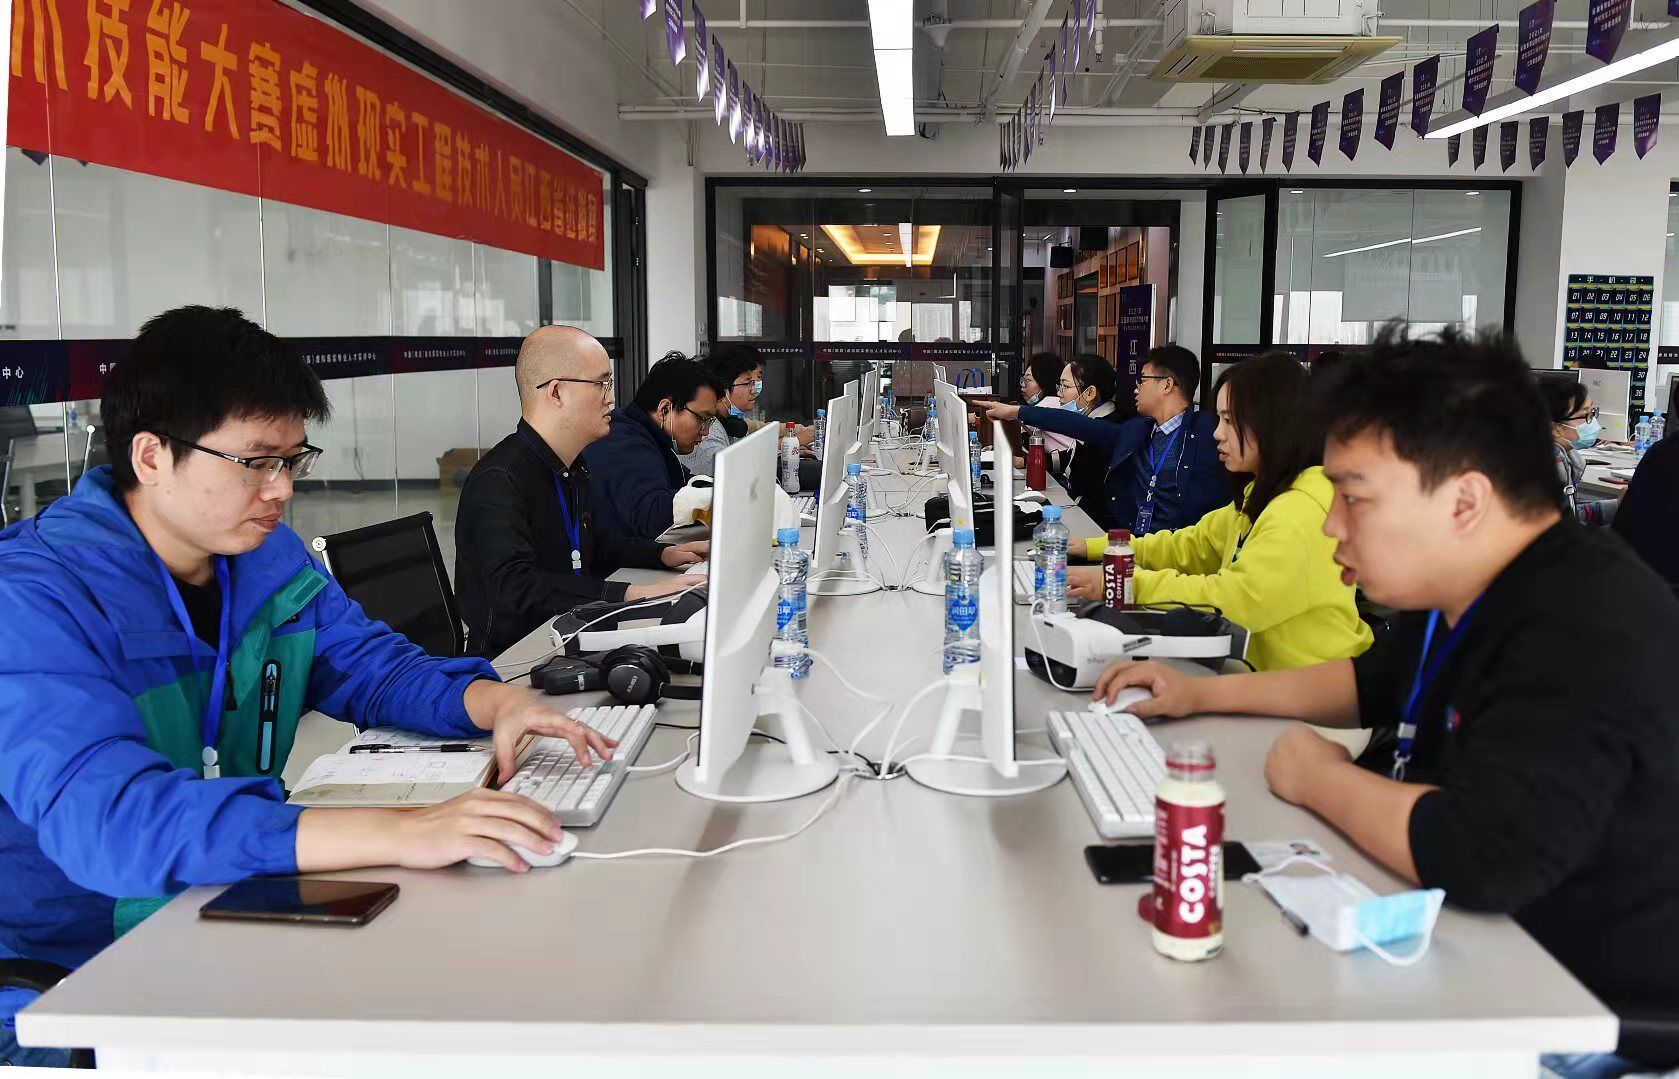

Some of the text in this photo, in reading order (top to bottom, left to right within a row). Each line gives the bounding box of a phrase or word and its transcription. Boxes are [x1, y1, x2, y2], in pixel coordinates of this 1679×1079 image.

[1571, 312, 1578, 320] 07
[1585, 312, 1593, 320] 08
[1600, 312, 1607, 320] 09
[1598, 332, 1605, 340] 15
[2, 366, 24, 379] 中心
[1178, 823, 1208, 924] COSTA
